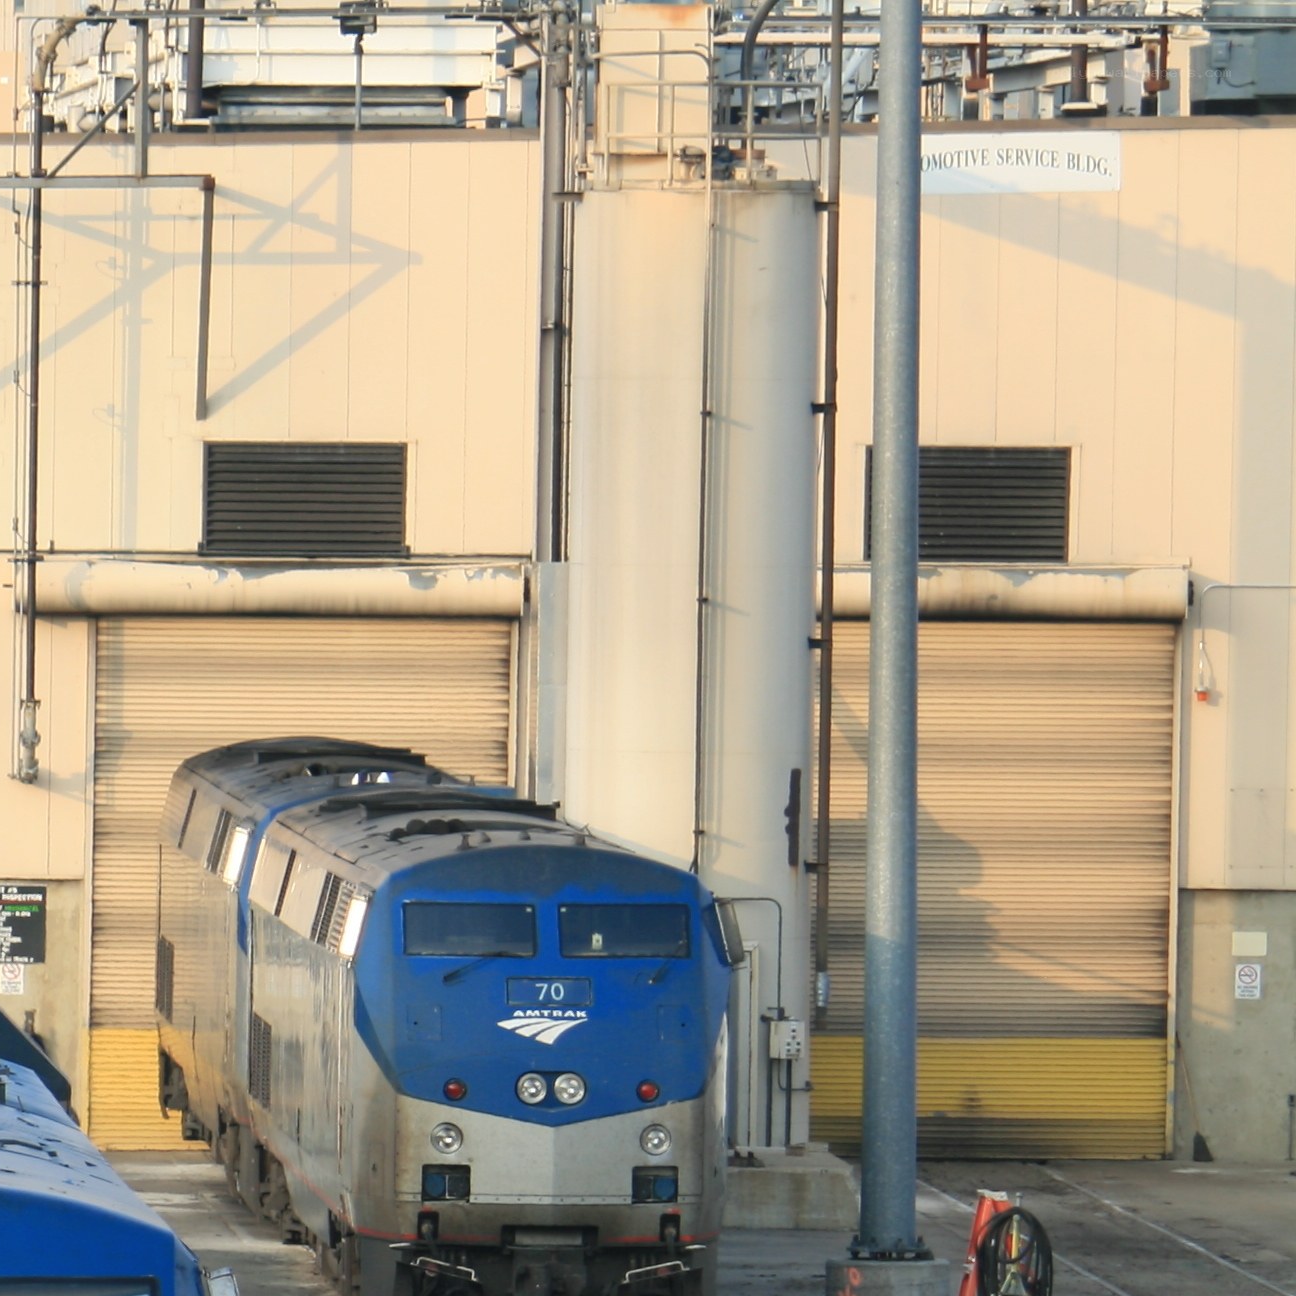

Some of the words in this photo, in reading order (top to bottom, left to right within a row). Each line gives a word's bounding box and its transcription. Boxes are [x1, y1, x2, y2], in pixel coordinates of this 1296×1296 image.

[920, 148, 990, 173] OMOTIVE
[996, 148, 1060, 168] SERVICE
[1066, 152, 1113, 177] BLDG.
[535, 982, 565, 1001] 70
[513, 1009, 588, 1018] AMTRAK
